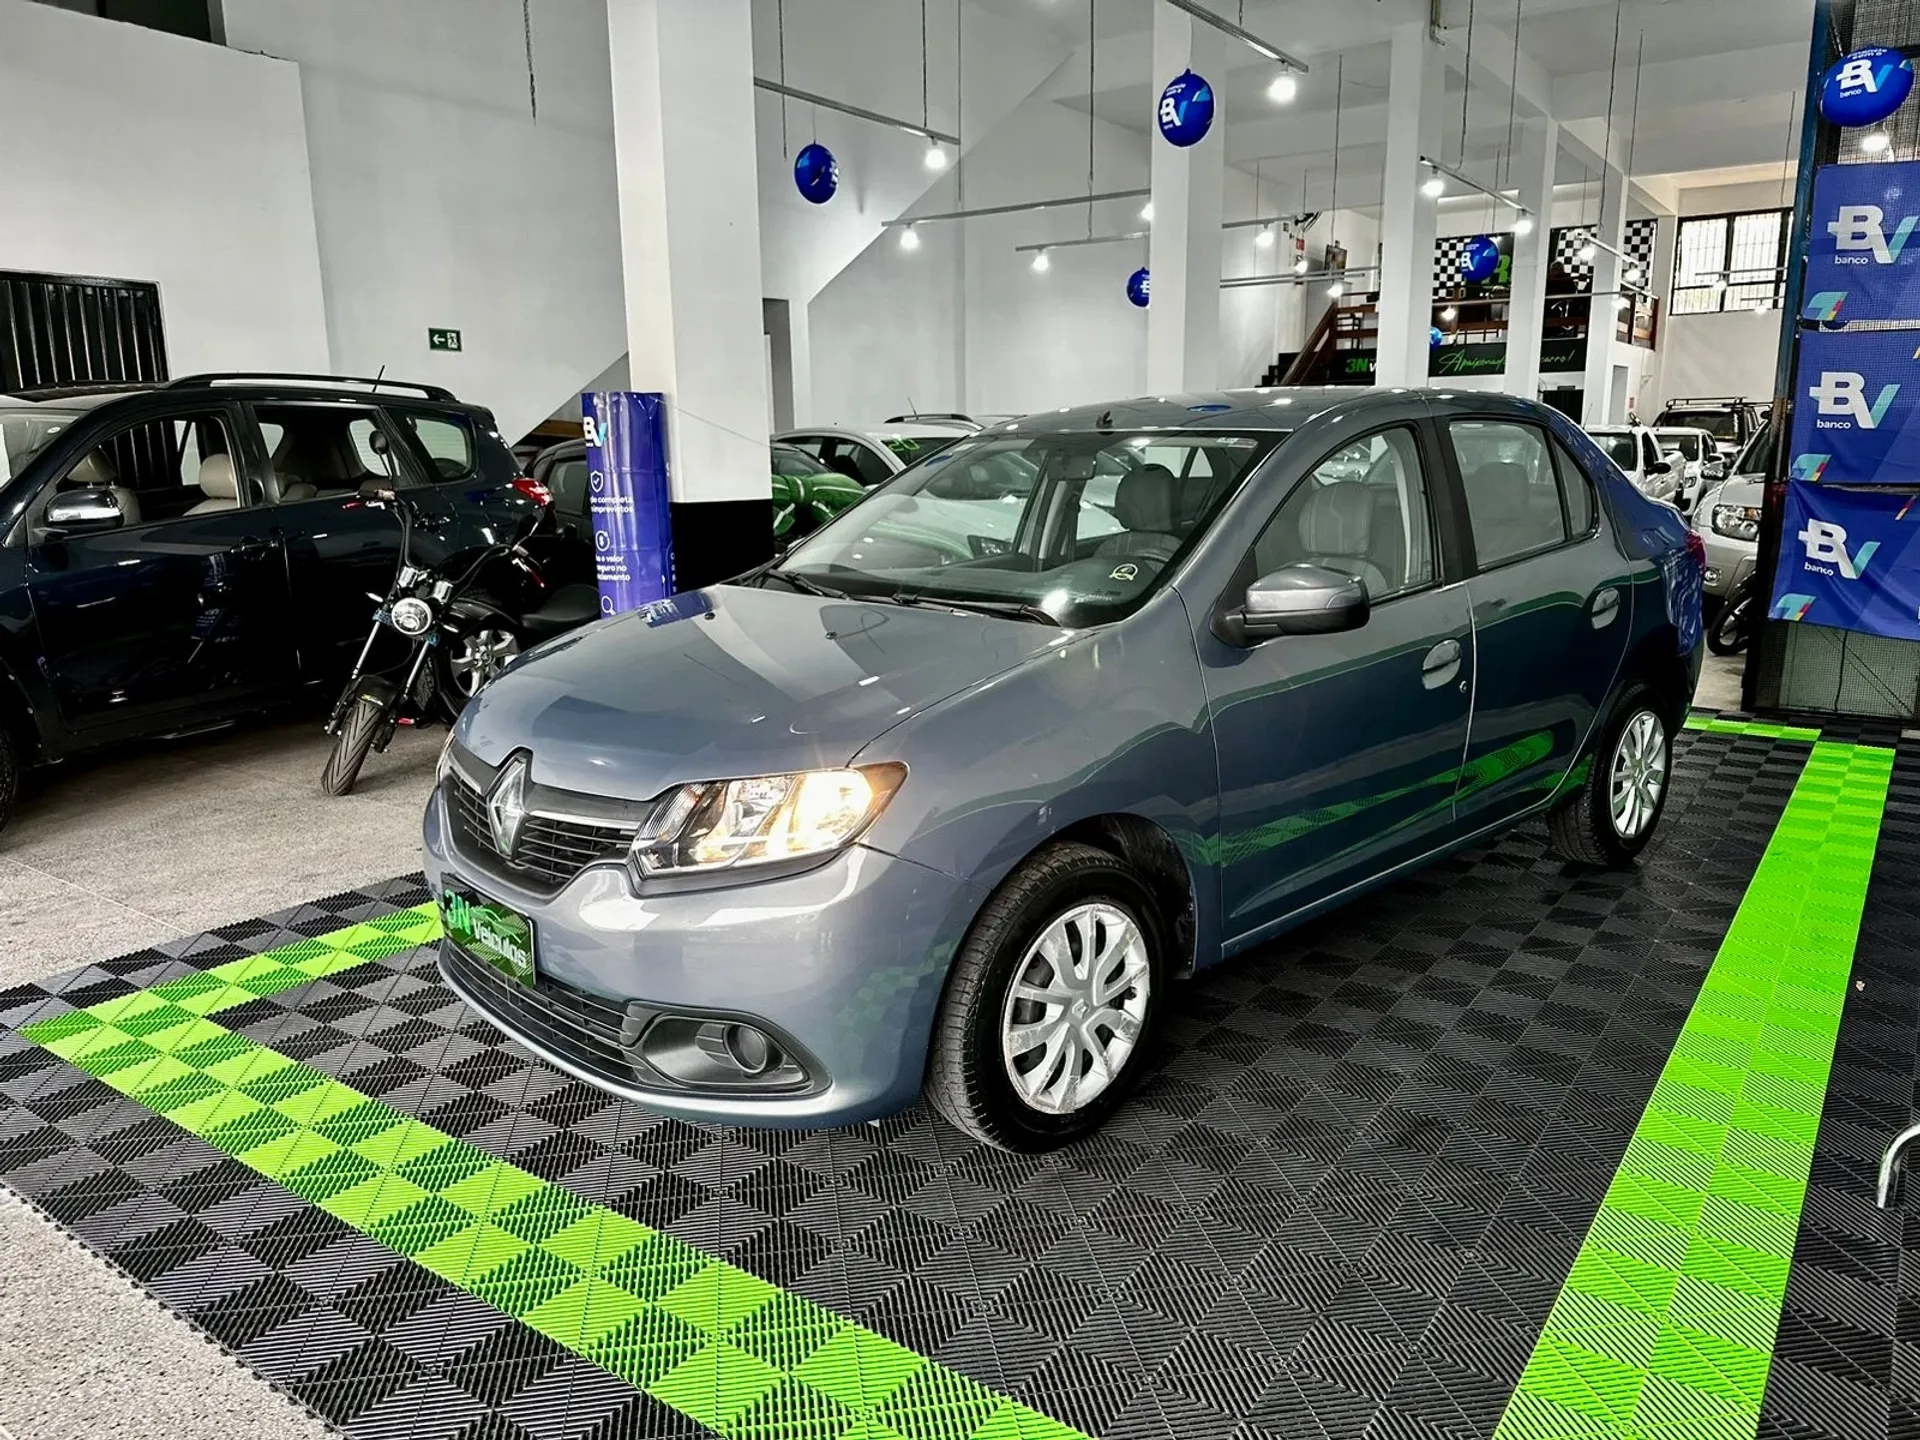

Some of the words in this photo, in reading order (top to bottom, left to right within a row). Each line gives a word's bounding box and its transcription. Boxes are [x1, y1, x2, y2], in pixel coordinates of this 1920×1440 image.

[1836, 59, 1894, 93] BV
[1840, 88, 1863, 99] banco
[1827, 205, 1920, 264] BV
[1834, 255, 1869, 265] banco
[1809, 371, 1901, 429] BV
[583, 416, 608, 448] BV
[1816, 419, 1852, 429] banco
[1798, 518, 1881, 580] BV
[1804, 561, 1834, 576] banco
[444, 888, 472, 936] 3N
